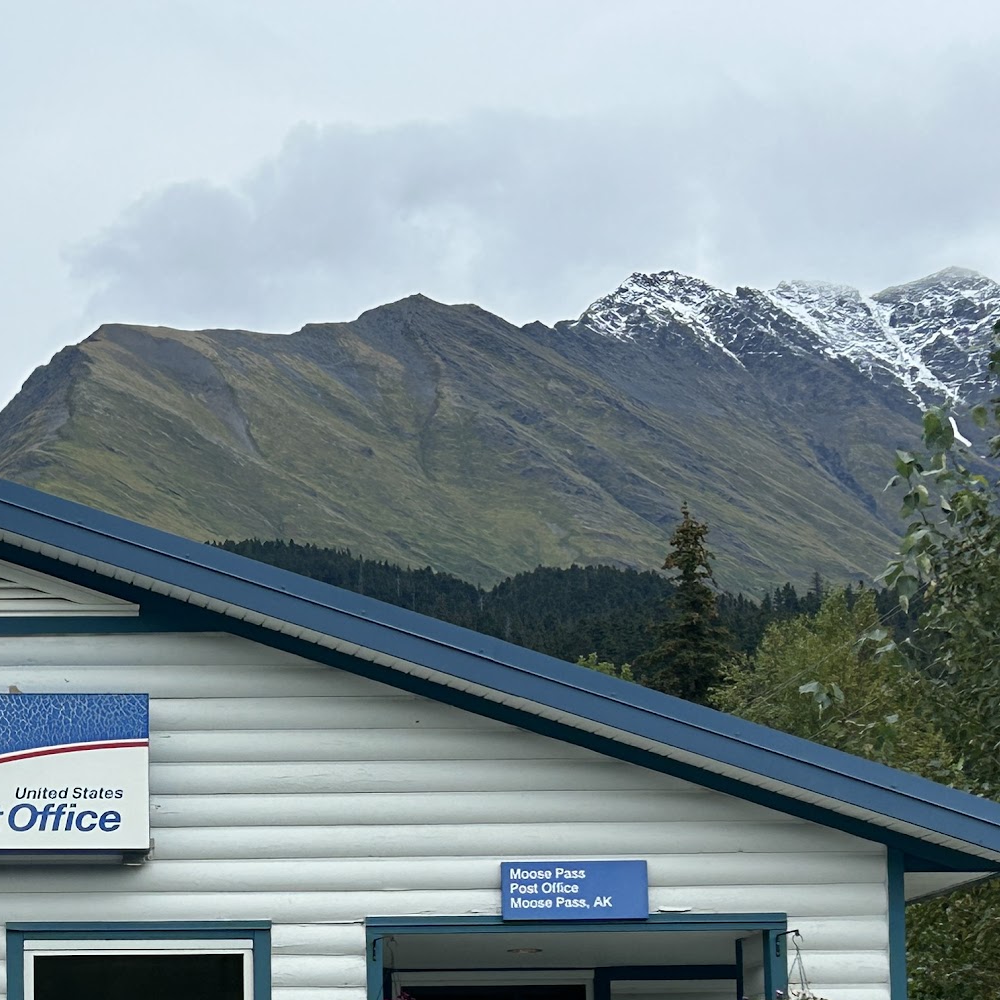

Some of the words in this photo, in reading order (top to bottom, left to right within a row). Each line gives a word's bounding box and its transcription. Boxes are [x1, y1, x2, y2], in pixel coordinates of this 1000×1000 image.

[14, 786, 68, 800] United
[72, 786, 124, 800] States
[7, 802, 122, 832] Office
[509, 868, 552, 879] Moose
[555, 867, 586, 879] Pass
[510, 882, 538, 894] Post
[541, 881, 579, 894] Office
[510, 897, 553, 909] Moose
[555, 896, 590, 909] Pass,
[593, 896, 613, 908] AK
